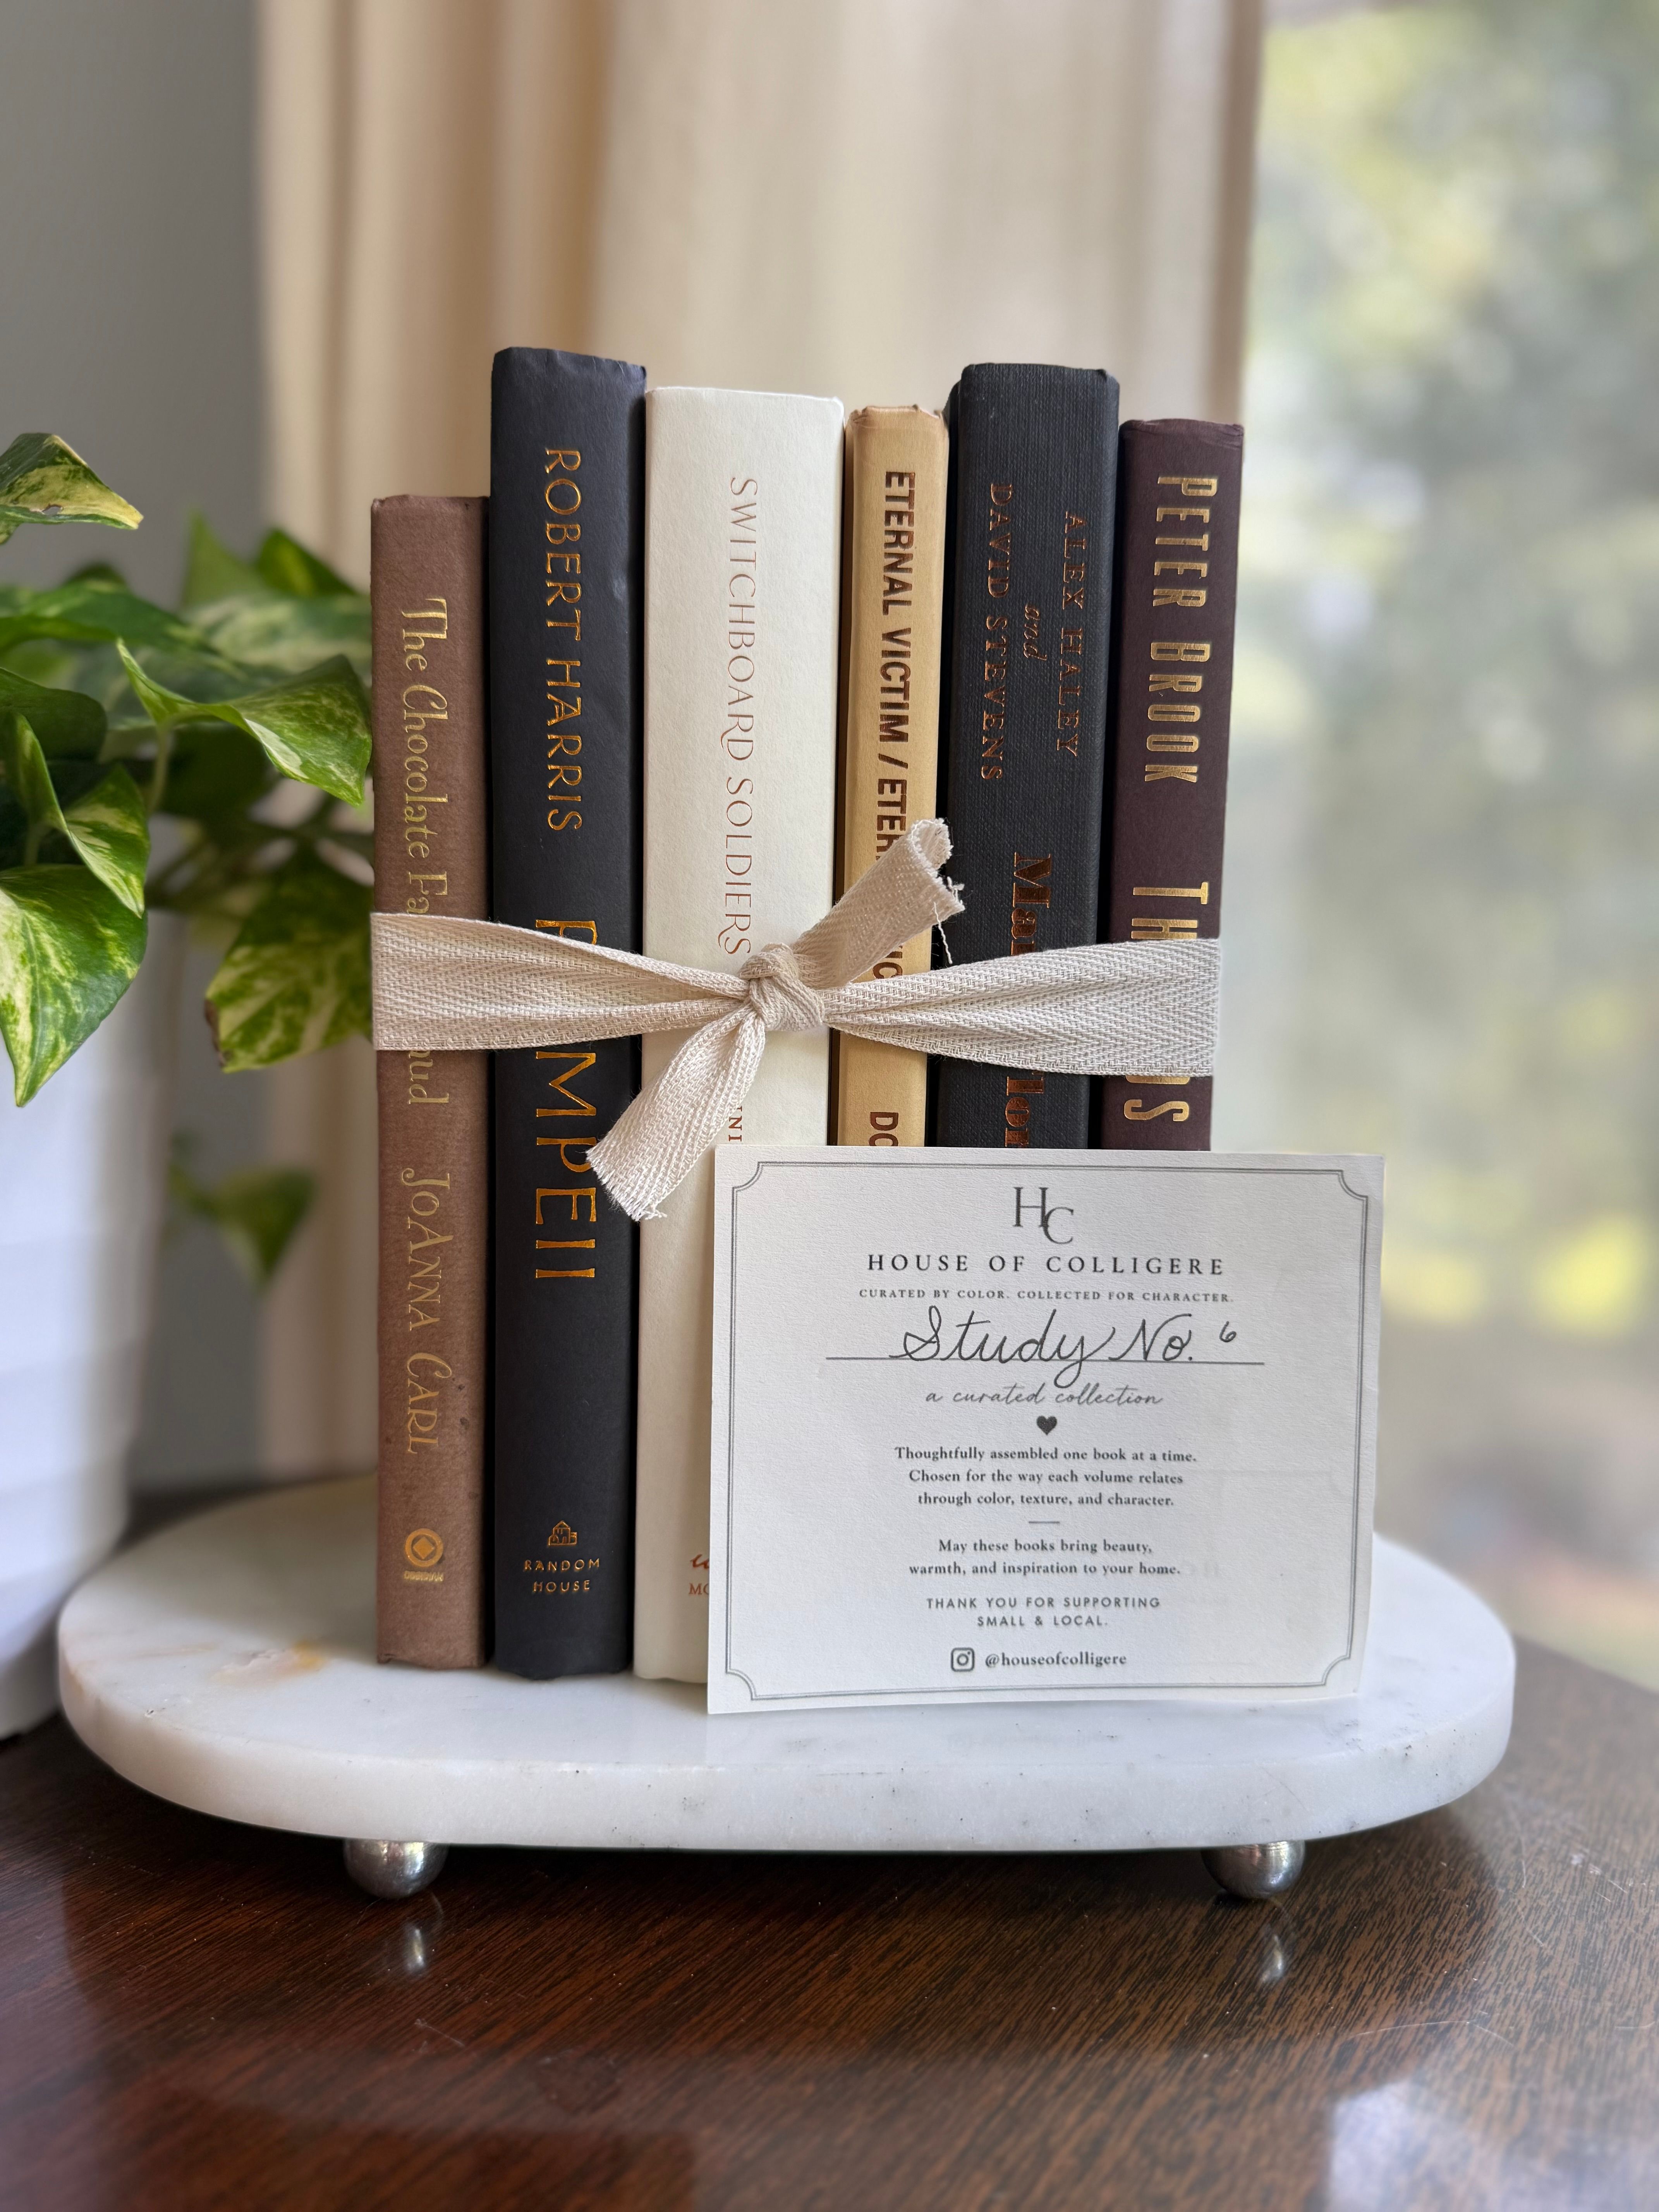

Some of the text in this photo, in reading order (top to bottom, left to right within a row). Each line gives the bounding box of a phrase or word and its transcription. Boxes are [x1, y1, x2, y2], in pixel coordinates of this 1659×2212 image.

[401, 598, 448, 672] The
[544, 448, 583, 831] ROBERT HARRIS
[981, 483, 1014, 780] DAVID STEVENS
[1023, 603, 1047, 661] and
[1056, 510, 1087, 758] ALEX HALEY
[1144, 476, 1218, 783] PETER BROOK
[876, 471, 915, 861] ETERNAL VICTIM / ETER
[718, 477, 758, 955] SWITCHBOARD SOLDIERS
[402, 684, 449, 859] Chocolate
[536, 919, 598, 1278] PMPEII
[867, 1254, 1223, 1276] HOUSE OF COLLIGERE
[859, 1289, 1234, 1303] CURATED BY COLOR. COLLECTED FOR CHARACTER.
[889, 1305, 1237, 1388] Study No. 6
[407, 1351, 452, 1455] CARL
[926, 1382, 1163, 1406] a curated collection
[893, 1446, 1197, 1462] Thoughtfully assembled one book at a time.
[908, 1468, 1184, 1485] Chosen for the way each volume relates
[918, 1491, 1174, 1507] through color, texture, and character.
[938, 1538, 1152, 1555] May these books bring beauty,
[523, 1558, 600, 1572] RANDOM
[908, 1560, 1181, 1577] warmth, and inspiration to your home.
[532, 1579, 591, 1593] HOUSE
[926, 1596, 1160, 1609] THANK YOU FOR SUPPORTING
[977, 1614, 1108, 1628] SMALL & LOCAL.
[984, 1651, 1127, 1669] @houseofcolligere
